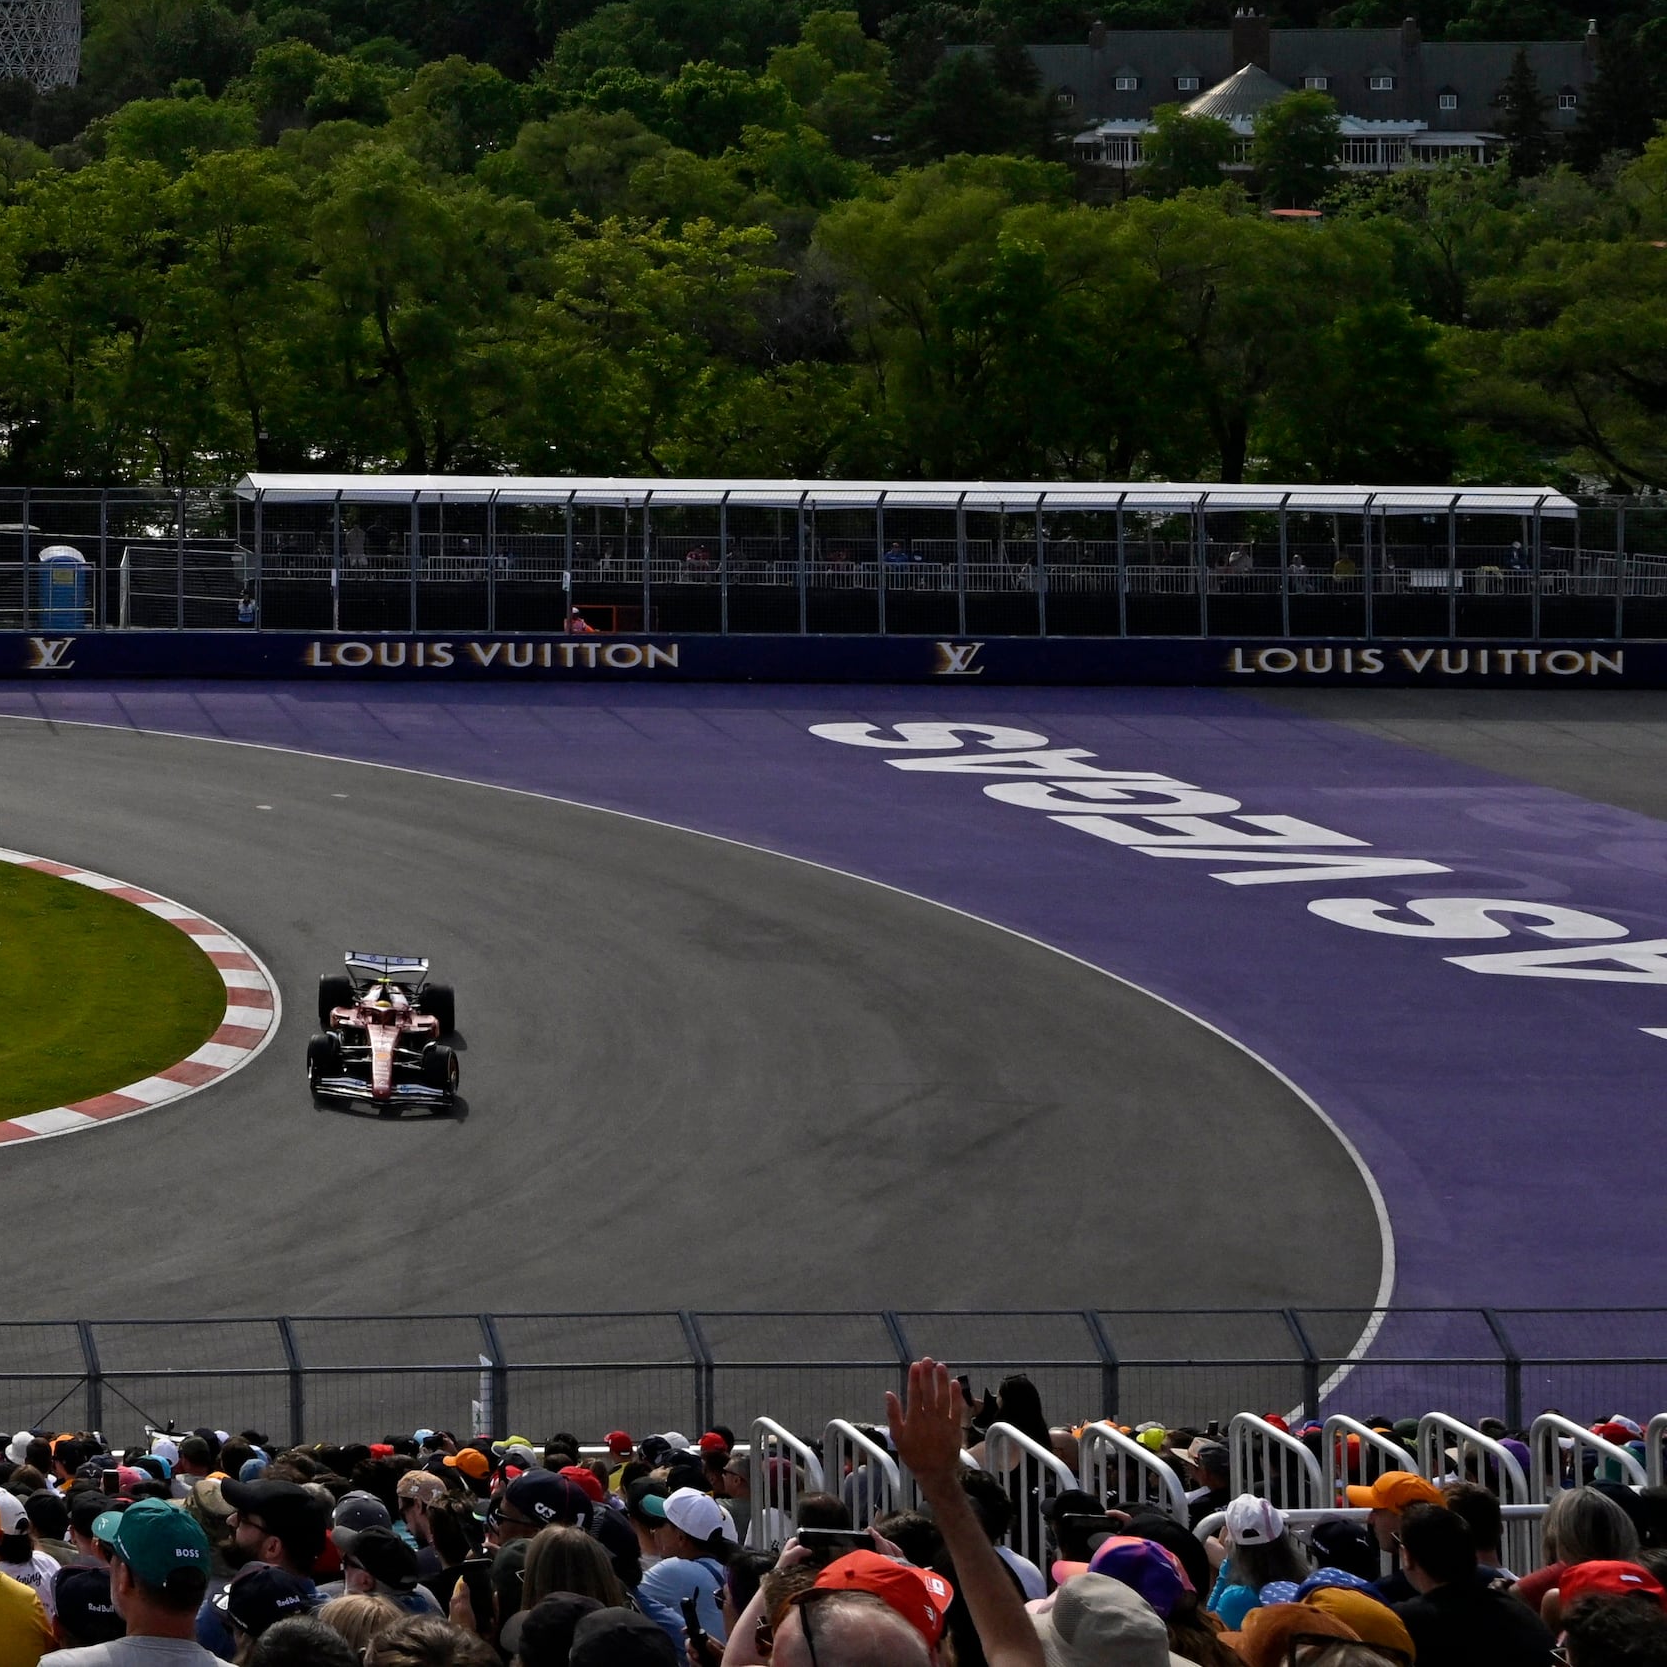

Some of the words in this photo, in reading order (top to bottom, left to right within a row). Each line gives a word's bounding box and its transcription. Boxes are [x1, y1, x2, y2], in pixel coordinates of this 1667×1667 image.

[312, 642, 454, 668] LOUIS
[471, 642, 679, 668] VUITTON
[1234, 647, 1384, 675] LOUIS
[1402, 647, 1623, 675] VUITTON
[175, 1548, 200, 1559] BOSS
